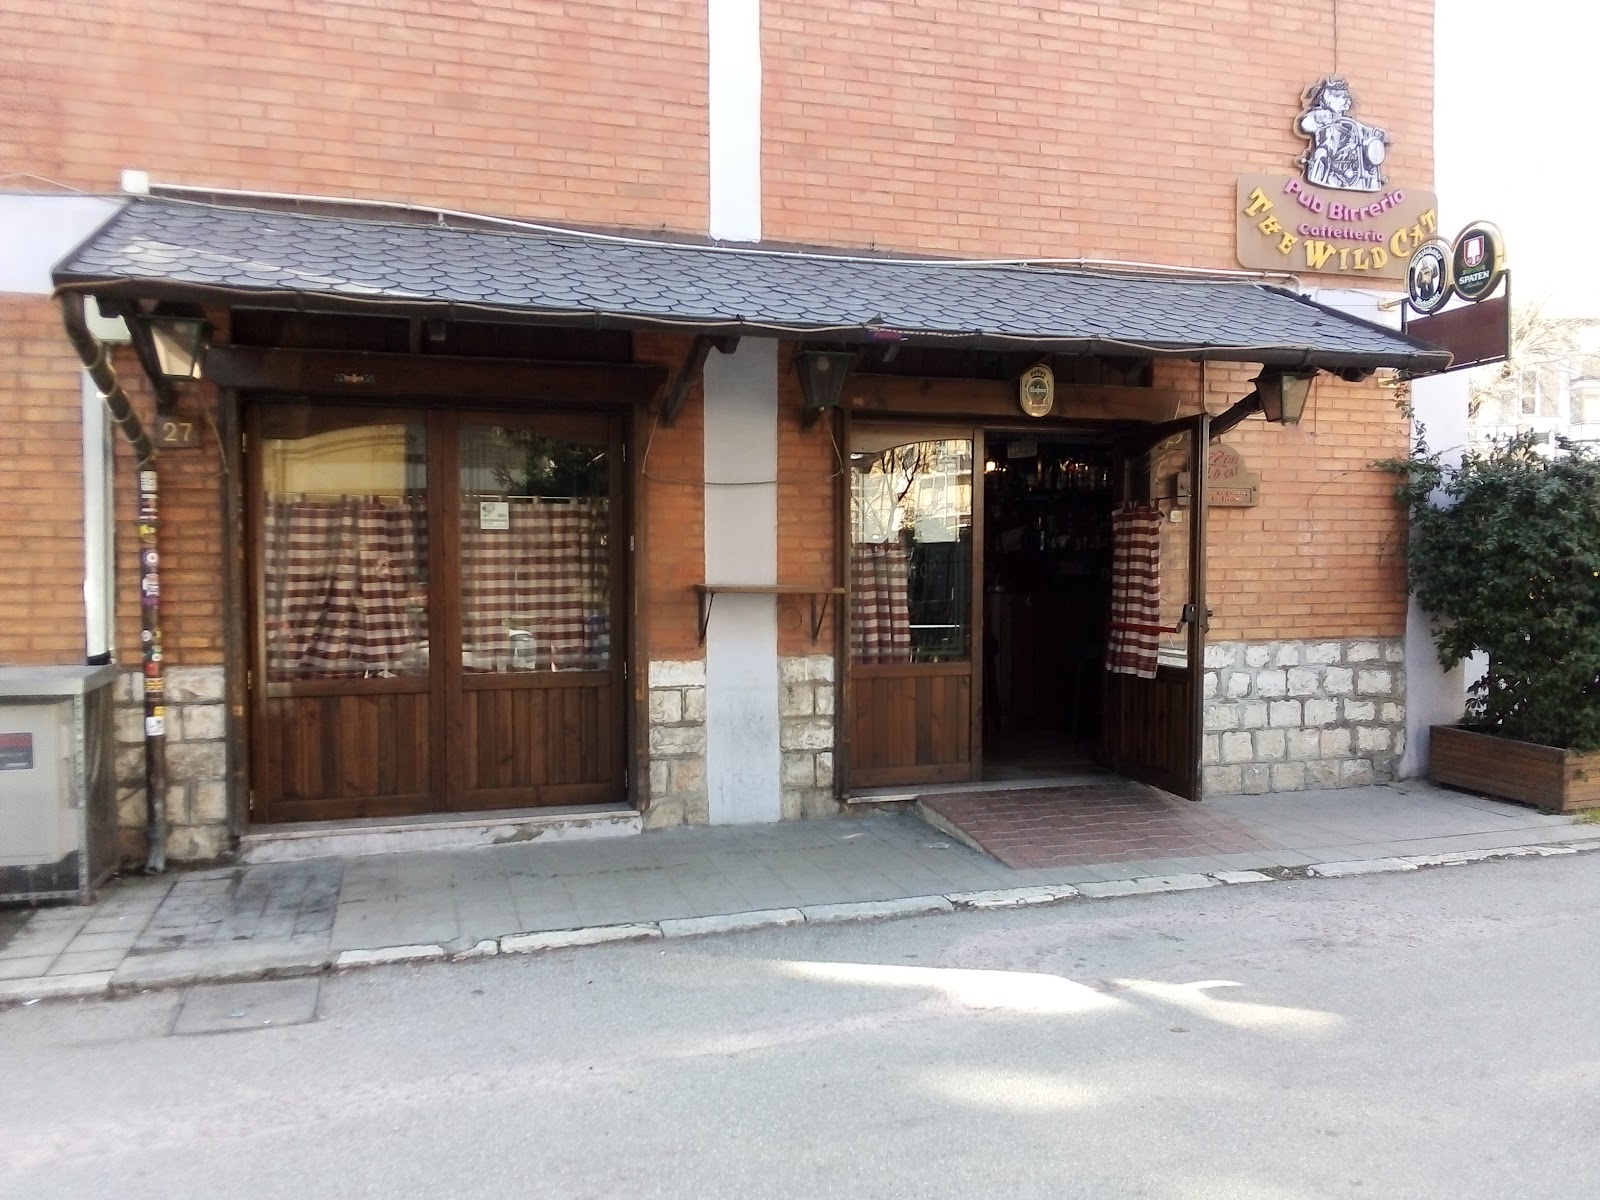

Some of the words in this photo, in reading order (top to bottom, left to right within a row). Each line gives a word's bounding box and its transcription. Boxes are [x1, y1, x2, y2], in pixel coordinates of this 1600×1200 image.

[1283, 178, 1323, 214] Pub
[1328, 189, 1406, 221] Birreria
[1243, 187, 1298, 255] THE
[1304, 240, 1388, 270] WILD
[1390, 208, 1436, 258] CAT
[1459, 270, 1490, 285] SPATEN
[163, 422, 193, 442] 27
